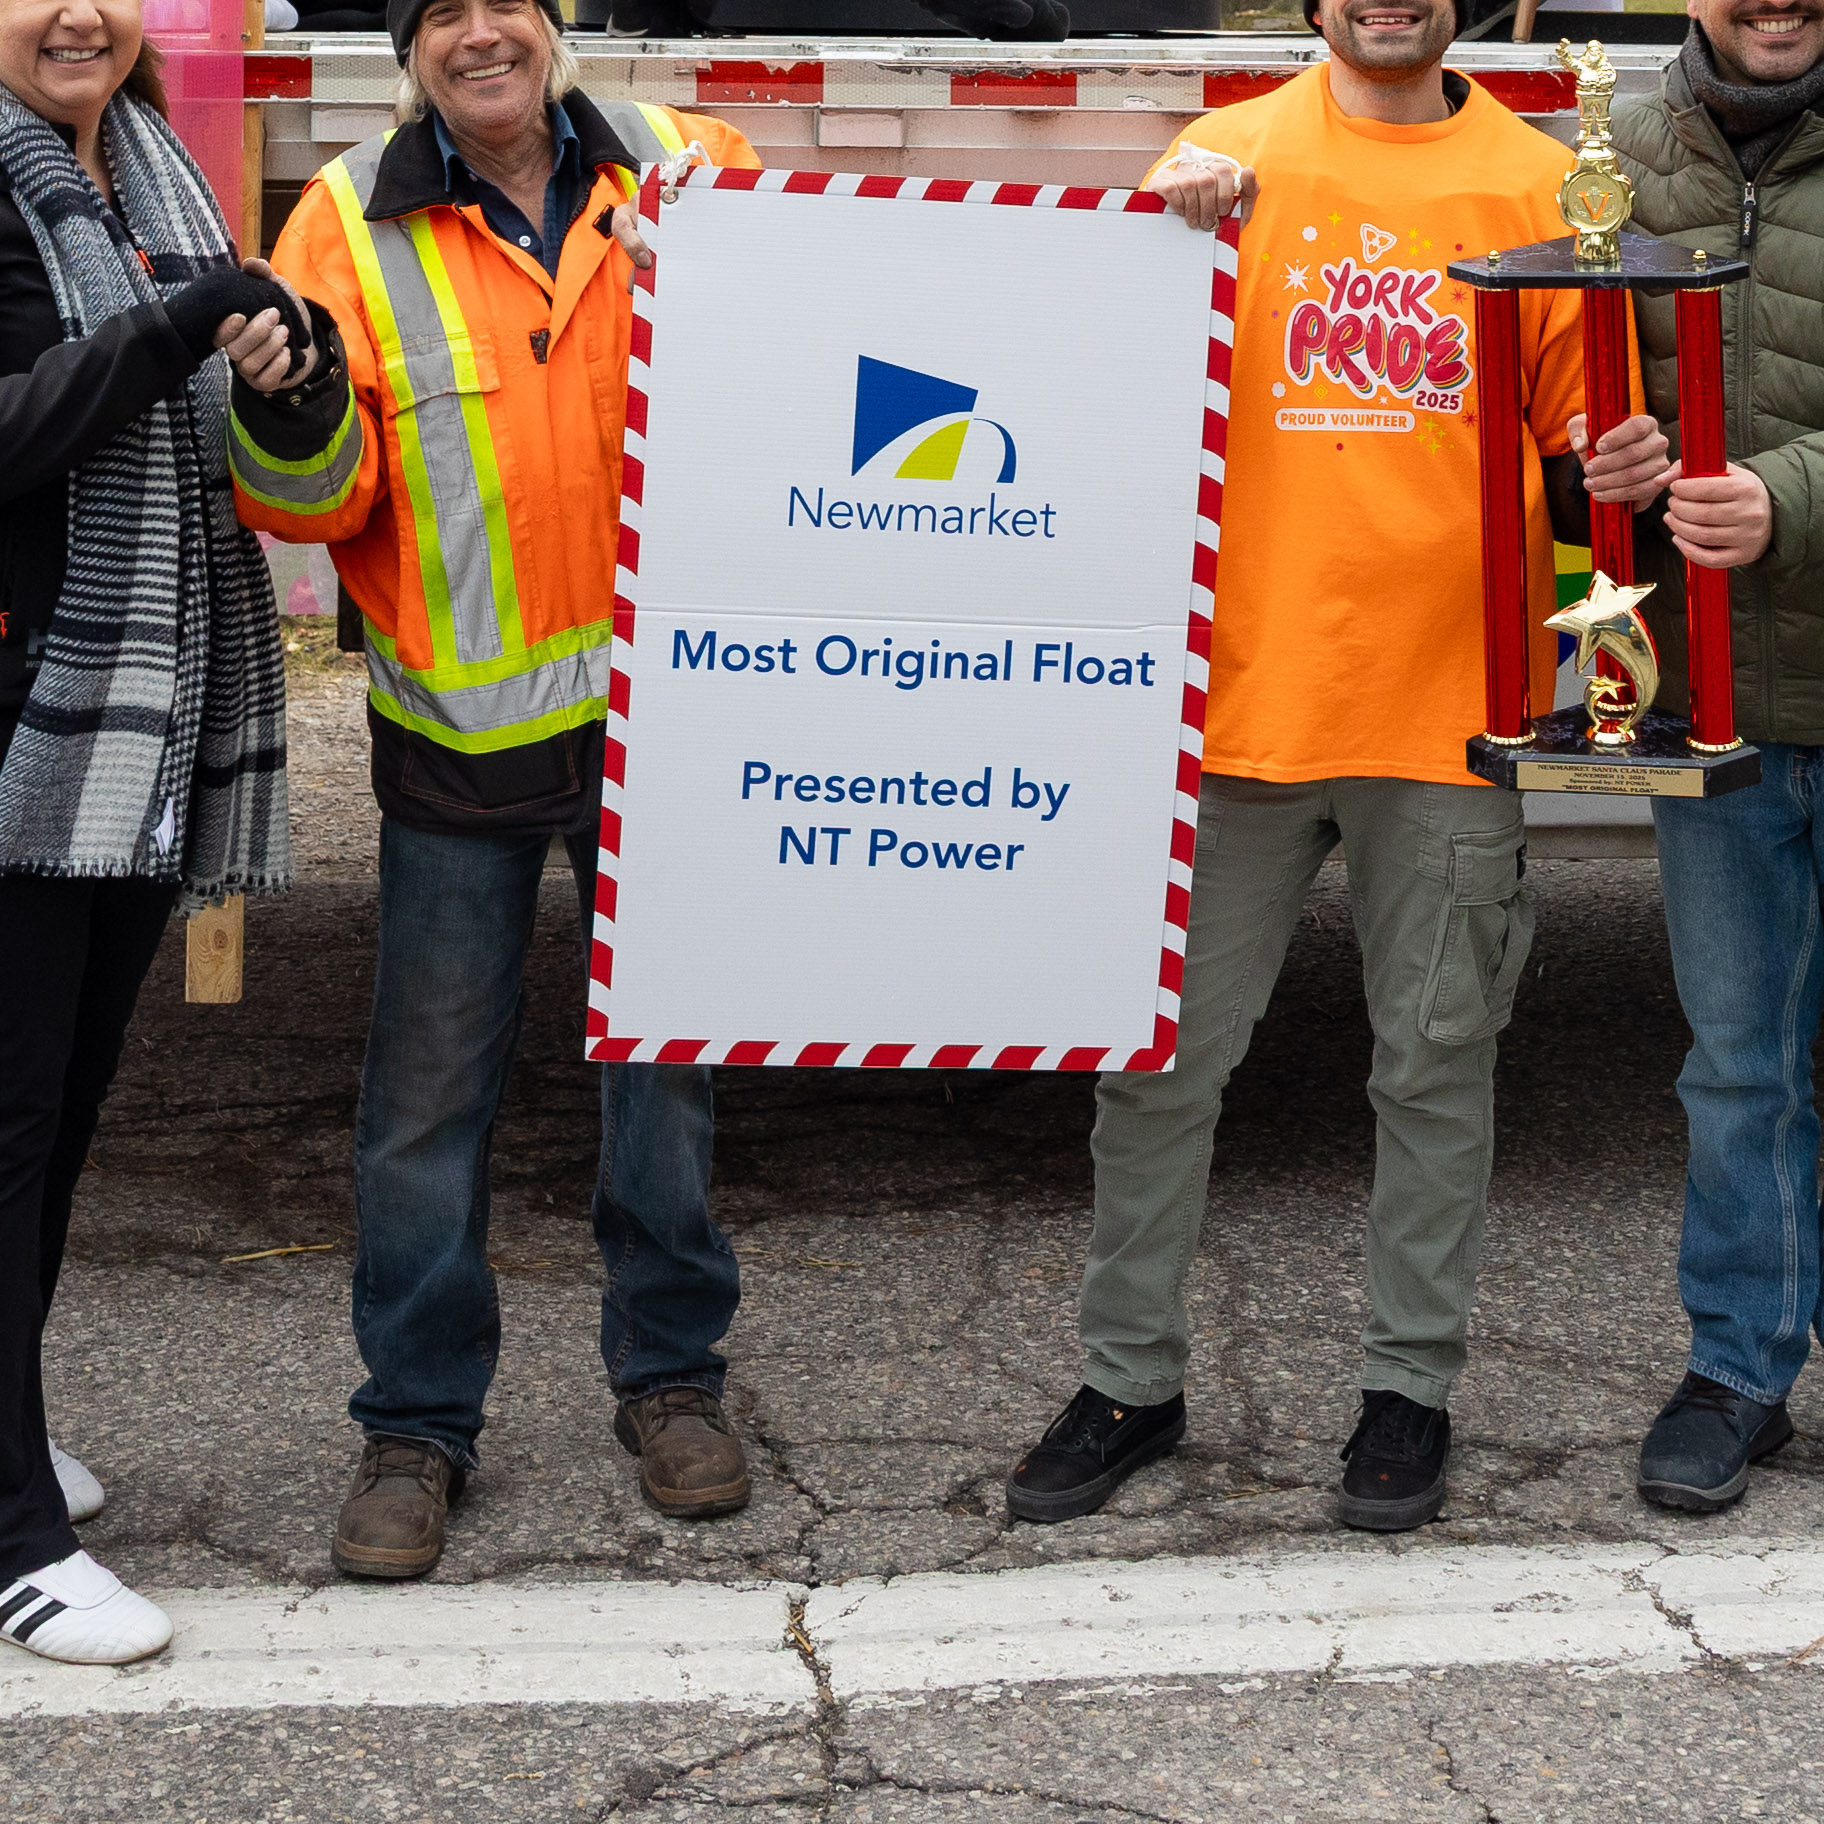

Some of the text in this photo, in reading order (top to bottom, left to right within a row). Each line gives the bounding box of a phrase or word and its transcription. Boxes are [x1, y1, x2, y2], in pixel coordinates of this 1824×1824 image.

[1323, 261, 1437, 326] YORK
[1289, 302, 1470, 395] PRIDE
[1280, 412, 1408, 428] PROUD VOLUNTEER
[1415, 389, 1460, 411] 2025
[787, 485, 1057, 538] Newmarket
[671, 629, 1156, 691] Most Original Float
[740, 760, 1071, 822] Presented by
[1537, 764, 1590, 773] NEWMARKET
[1592, 766, 1619, 774] SANTA
[777, 825, 1025, 872] NT Power
